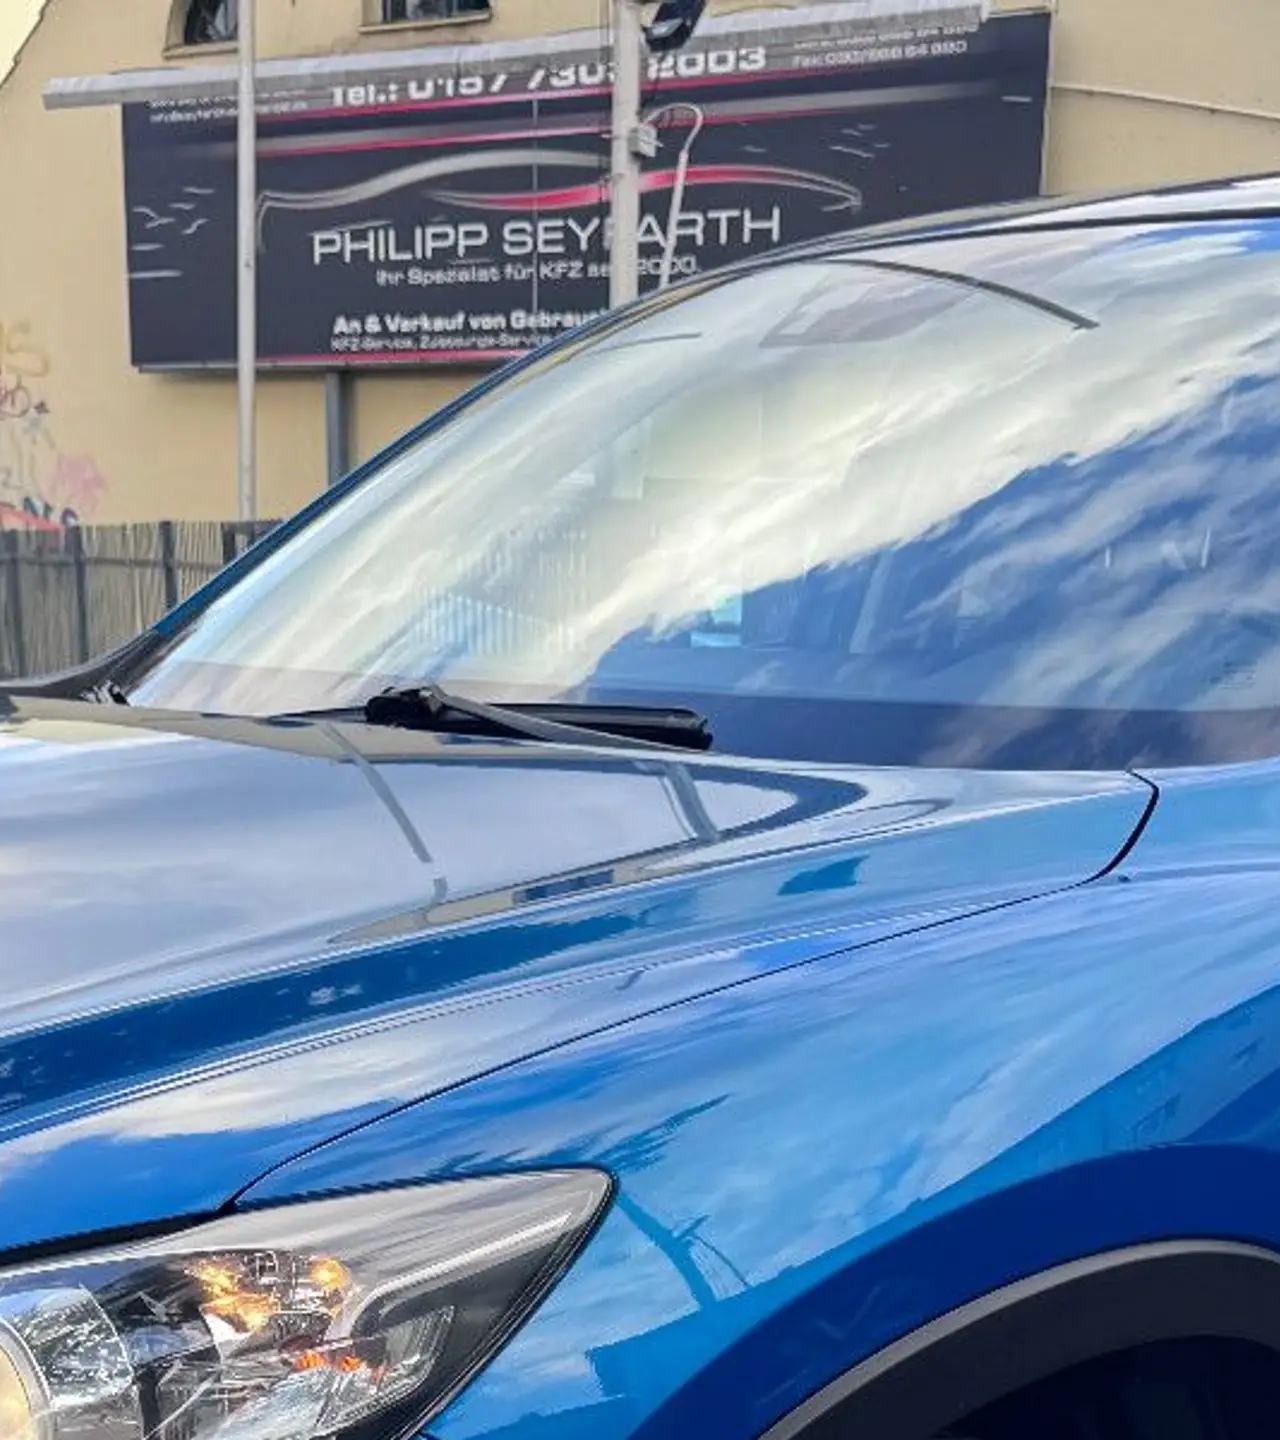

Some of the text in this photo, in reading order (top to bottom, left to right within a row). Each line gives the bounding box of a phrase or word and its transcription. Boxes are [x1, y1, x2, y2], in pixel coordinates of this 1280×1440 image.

[312, 221, 490, 265] PHILIPP
[539, 259, 584, 280] KFZ
[332, 314, 362, 335] An
[384, 310, 465, 333] Verkauf
[468, 310, 507, 330] von
